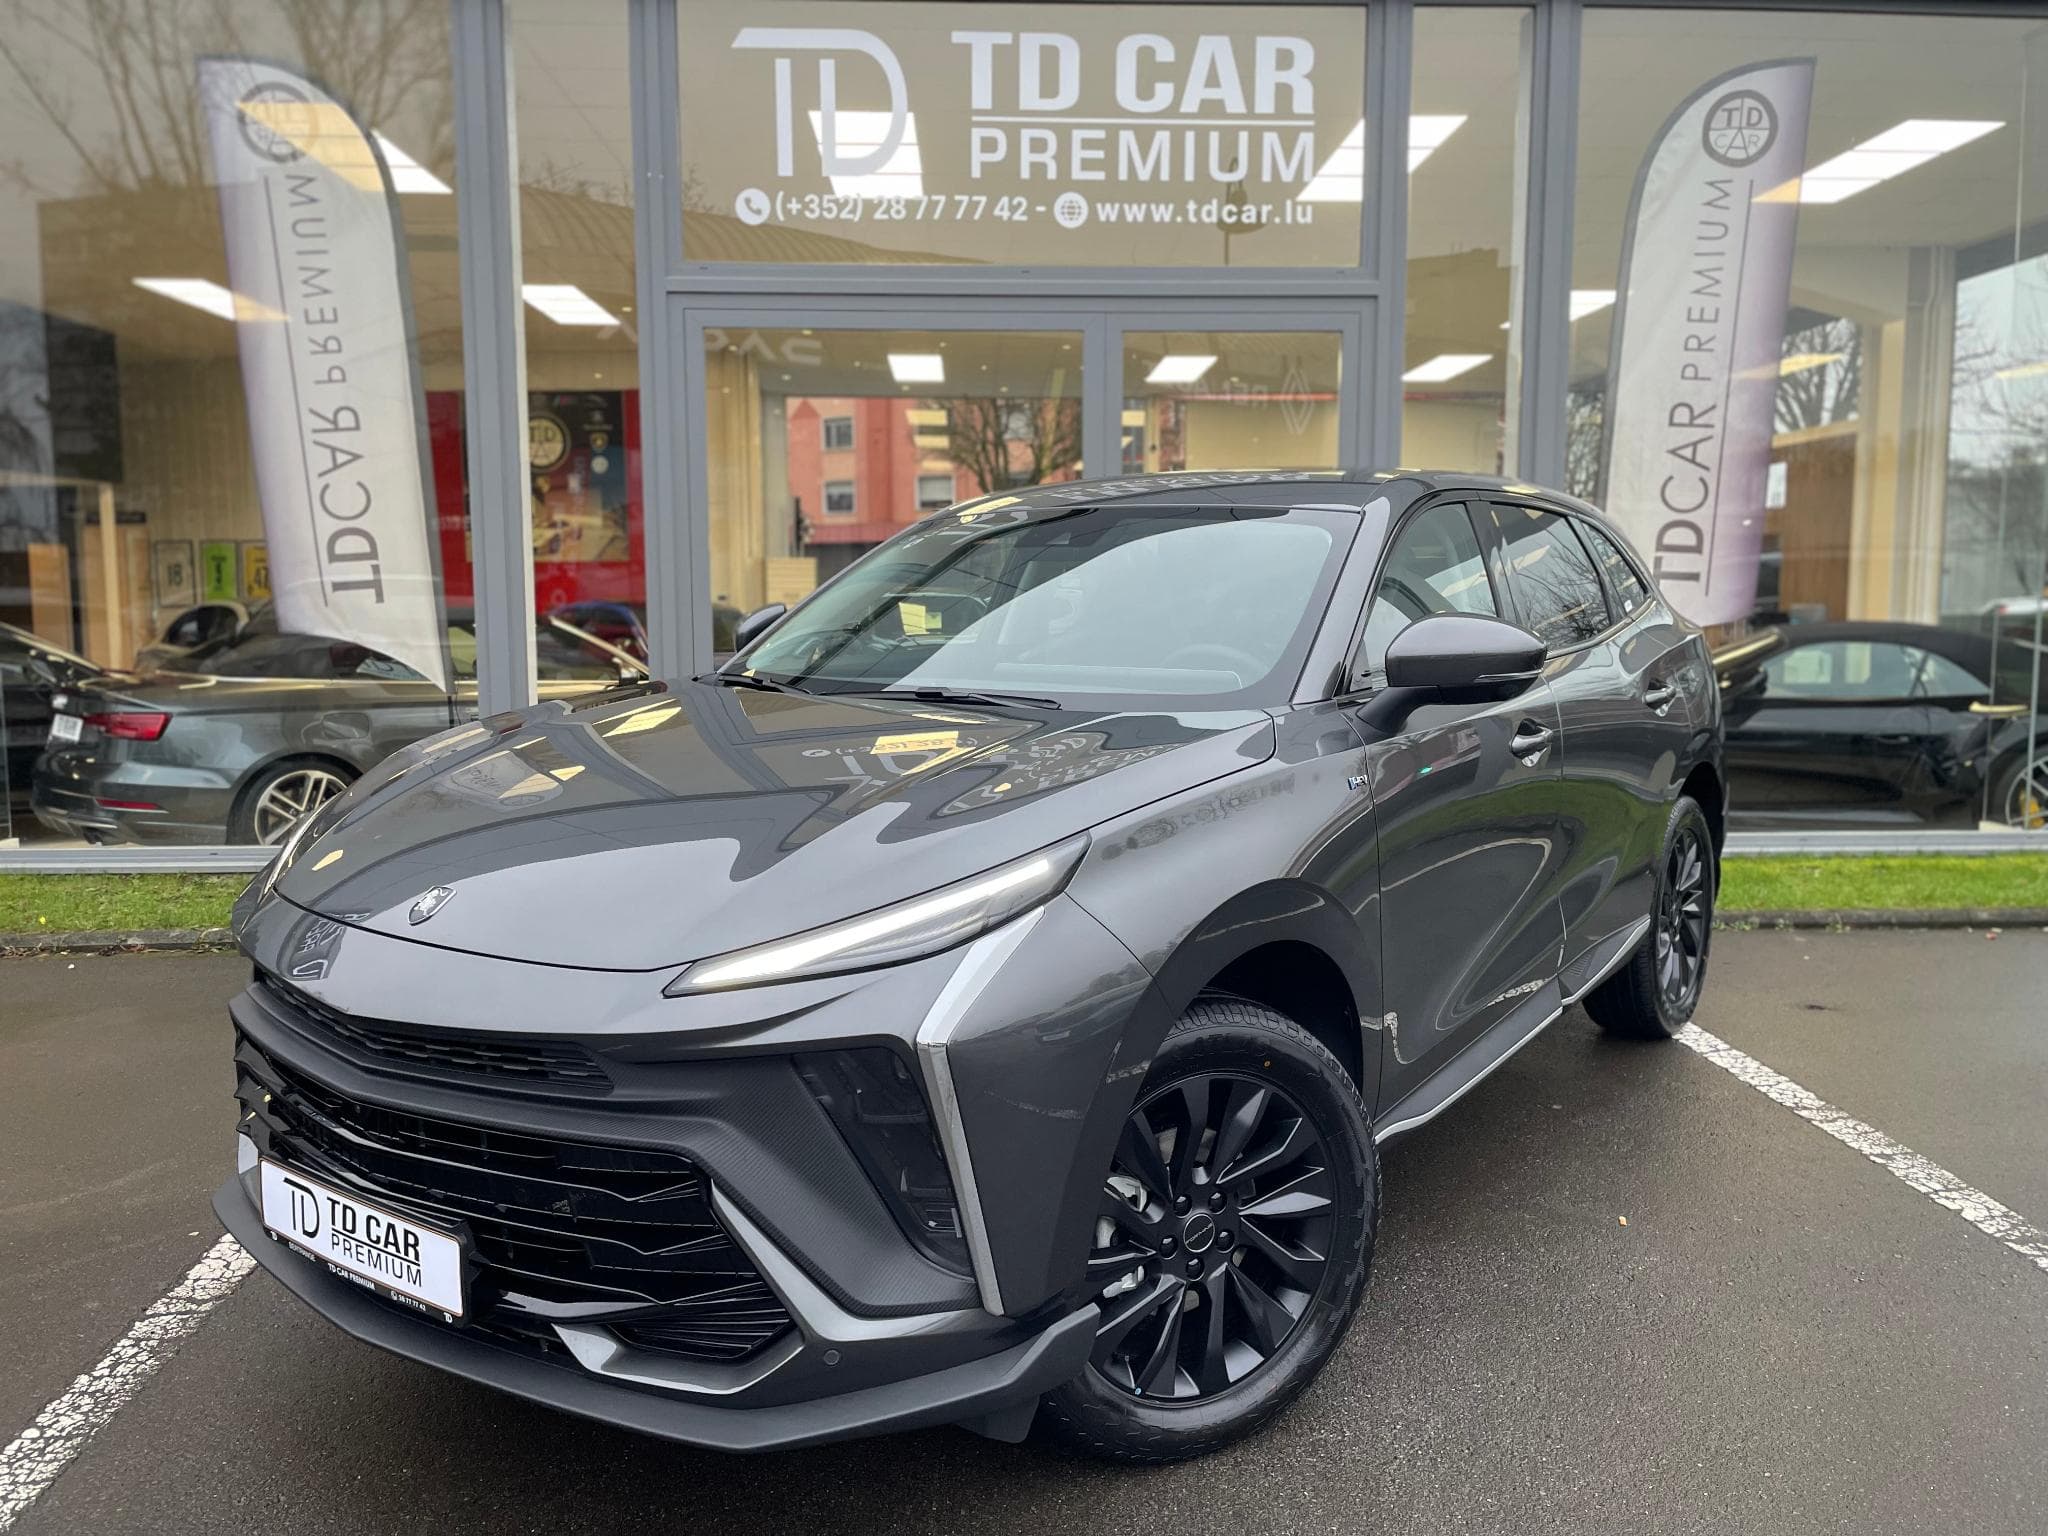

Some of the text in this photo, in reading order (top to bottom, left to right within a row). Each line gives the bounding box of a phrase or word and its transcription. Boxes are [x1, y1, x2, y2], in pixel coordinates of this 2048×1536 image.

[951, 31, 1316, 115] TD CAR
[1721, 106, 1763, 129] TD
[970, 127, 1315, 184] PREMIUM
[775, 194, 863, 222] (+352)
[872, 197, 907, 221] 28
[914, 196, 948, 220] 77
[954, 196, 988, 221] 77
[993, 196, 1028, 222] 42
[1097, 199, 1314, 225] www.tdcar.lu
[1652, 177, 1735, 589] TDCAR PREMIUM
[327, 1196, 420, 1264] TD CAR
[328, 1263, 376, 1291] TD CAR PREMIUM
[331, 1233, 422, 1288] PREMIUM
[443, 1312, 453, 1324] TD
